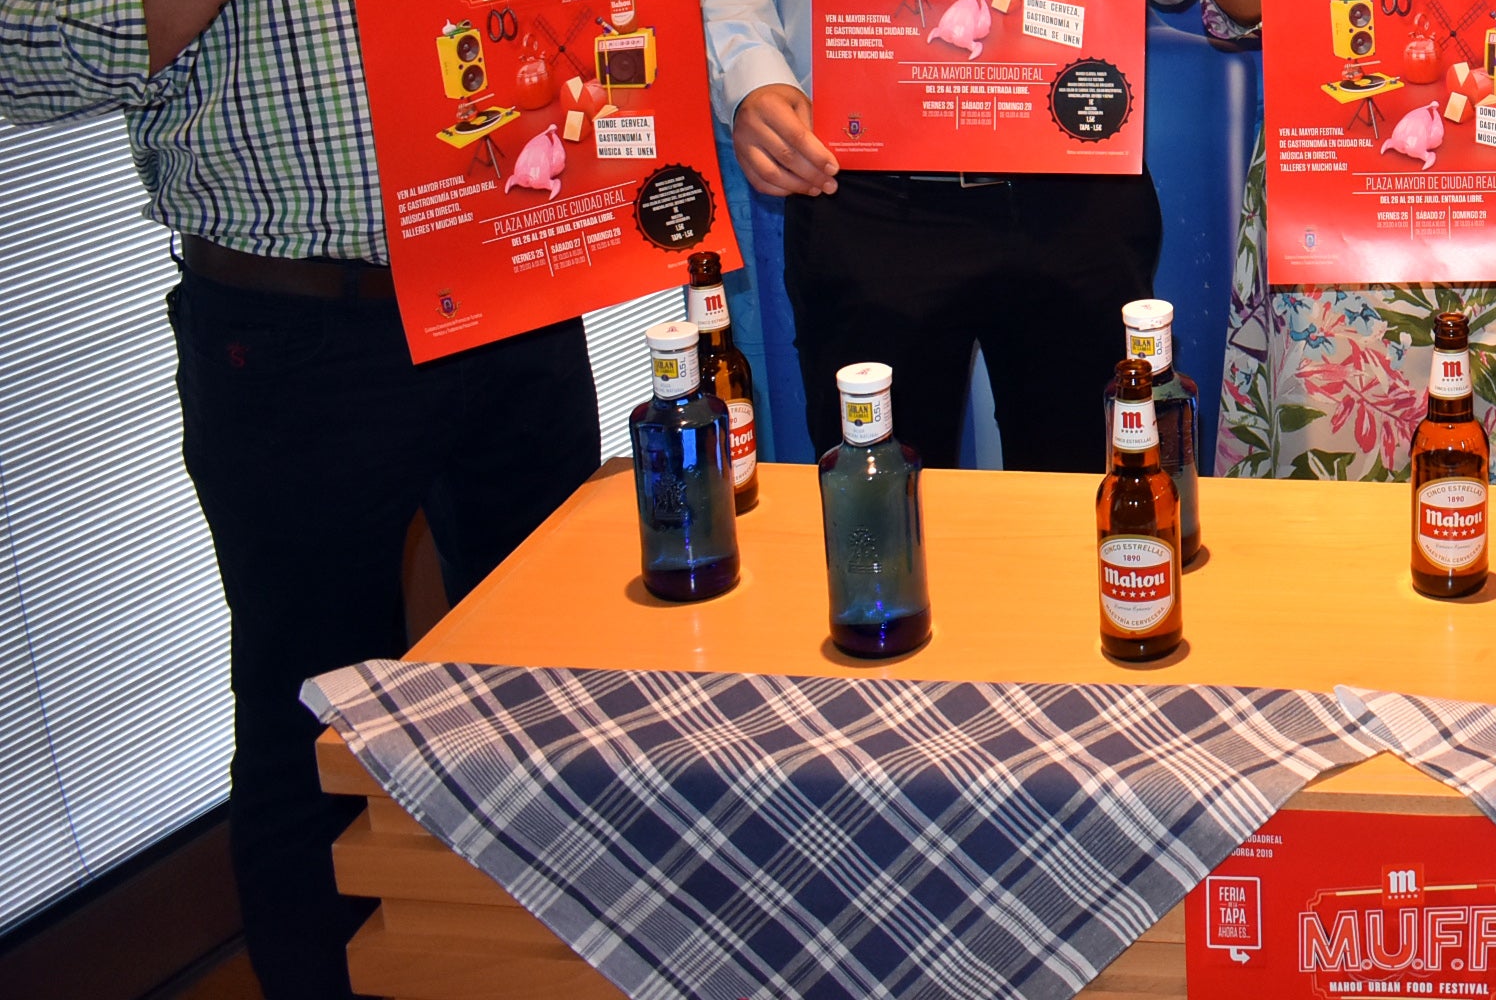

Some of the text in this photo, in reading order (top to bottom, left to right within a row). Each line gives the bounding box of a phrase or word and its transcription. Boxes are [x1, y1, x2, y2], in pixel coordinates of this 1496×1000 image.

[910, 63, 1044, 80] PLAZA MAYOR DE CIUDAD REAL
[1364, 174, 1392, 190] PLAZA
[1395, 174, 1426, 189] MAYOR
[1428, 176, 1438, 189] DE
[1439, 173, 1473, 189] CIUDAD
[494, 190, 626, 235] PLAZA MAYOR DE CIUDAD REAL
[730, 430, 753, 447] hou
[1427, 485, 1483, 498] CINCO ESTRELLAS
[1426, 509, 1482, 527] Mahou
[1104, 544, 1164, 557] CINCO ESTRELLAS
[1104, 567, 1165, 588] Mahou
[1131, 607, 1165, 626] CERVECERA
[1253, 849, 1272, 858] 2019
[1220, 887, 1245, 903] FERIA
[1220, 906, 1246, 924] TAPA
[1218, 927, 1238, 937] AHORA
[1330, 982, 1488, 994] MAHOU URBAN FOOD FESTIVAL
